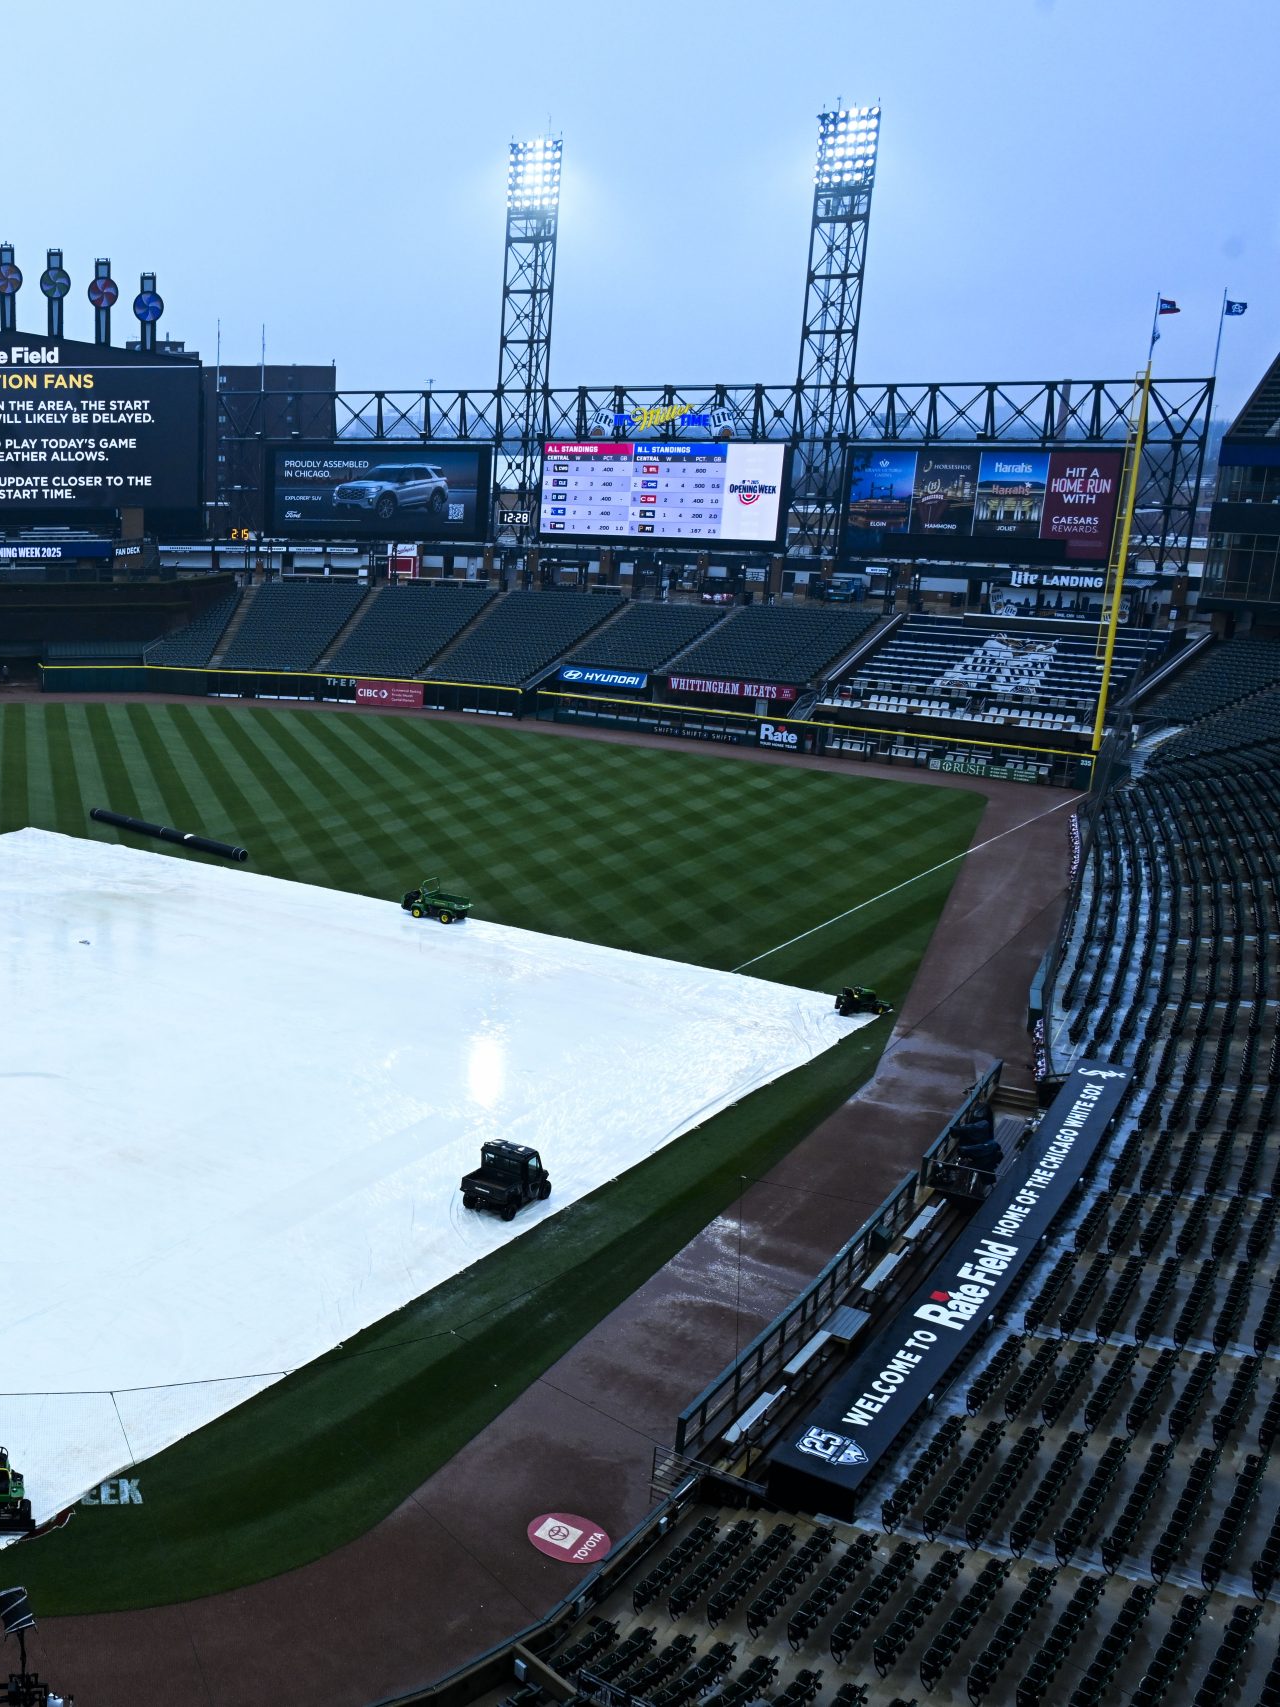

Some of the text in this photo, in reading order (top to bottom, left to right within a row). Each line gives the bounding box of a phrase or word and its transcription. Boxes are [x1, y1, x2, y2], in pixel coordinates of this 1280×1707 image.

[12, 347, 59, 364] Field
[44, 374, 93, 388] FANS
[8, 401, 33, 411] THE
[38, 401, 77, 412] AREA,
[80, 401, 105, 410] THE
[110, 400, 150, 410] START
[26, 413, 68, 423] LIKELY
[72, 413, 88, 423] BE
[93, 413, 154, 423] DELAYED.
[594, 412, 614, 427] Lite
[631, 403, 711, 432] Miller TIME
[713, 411, 734, 427] Lite
[5, 439, 37, 449] PLAY
[41, 439, 95, 448] TODAY'S
[99, 439, 136, 448] GAME
[51, 451, 108, 461] ALLOWS.
[285, 460, 321, 468] PROUDLY
[1066, 468, 1099, 477] HIT A
[0, 477, 48, 486] UPDATE
[52, 476, 102, 486] CLOSER
[106, 476, 123, 486] TO
[127, 476, 152, 486] THE
[1051, 478, 1111, 493] HOME RUN
[0, 489, 38, 499] START
[42, 489, 75, 499] TIME.
[729, 484, 776, 494] OPENING WEEK
[1063, 494, 1096, 504] WITH
[503, 513, 528, 524] 12:28
[1052, 516, 1098, 525] CAESARS
[231, 528, 249, 540] 2:15
[1052, 525, 1098, 533] REWARDS
[18, 547, 40, 557] WEEK
[41, 547, 61, 557] 2025
[116, 546, 140, 556] FAN DECK
[1010, 571, 1103, 588] Lite LANDING
[584, 672, 639, 685] HYUNDAI
[358, 688, 378, 697] CIBC
[671, 677, 739, 695] WHITTINGHAM
[743, 684, 776, 698] MEATS
[760, 723, 797, 743] Rate
[953, 763, 985, 775] RUSH
[841, 1082, 1105, 1427] WELCOME TO Rate Field HOME OF THE CHICAGO WHITE SOX
[572, 1532, 605, 1560] TOYOTA
